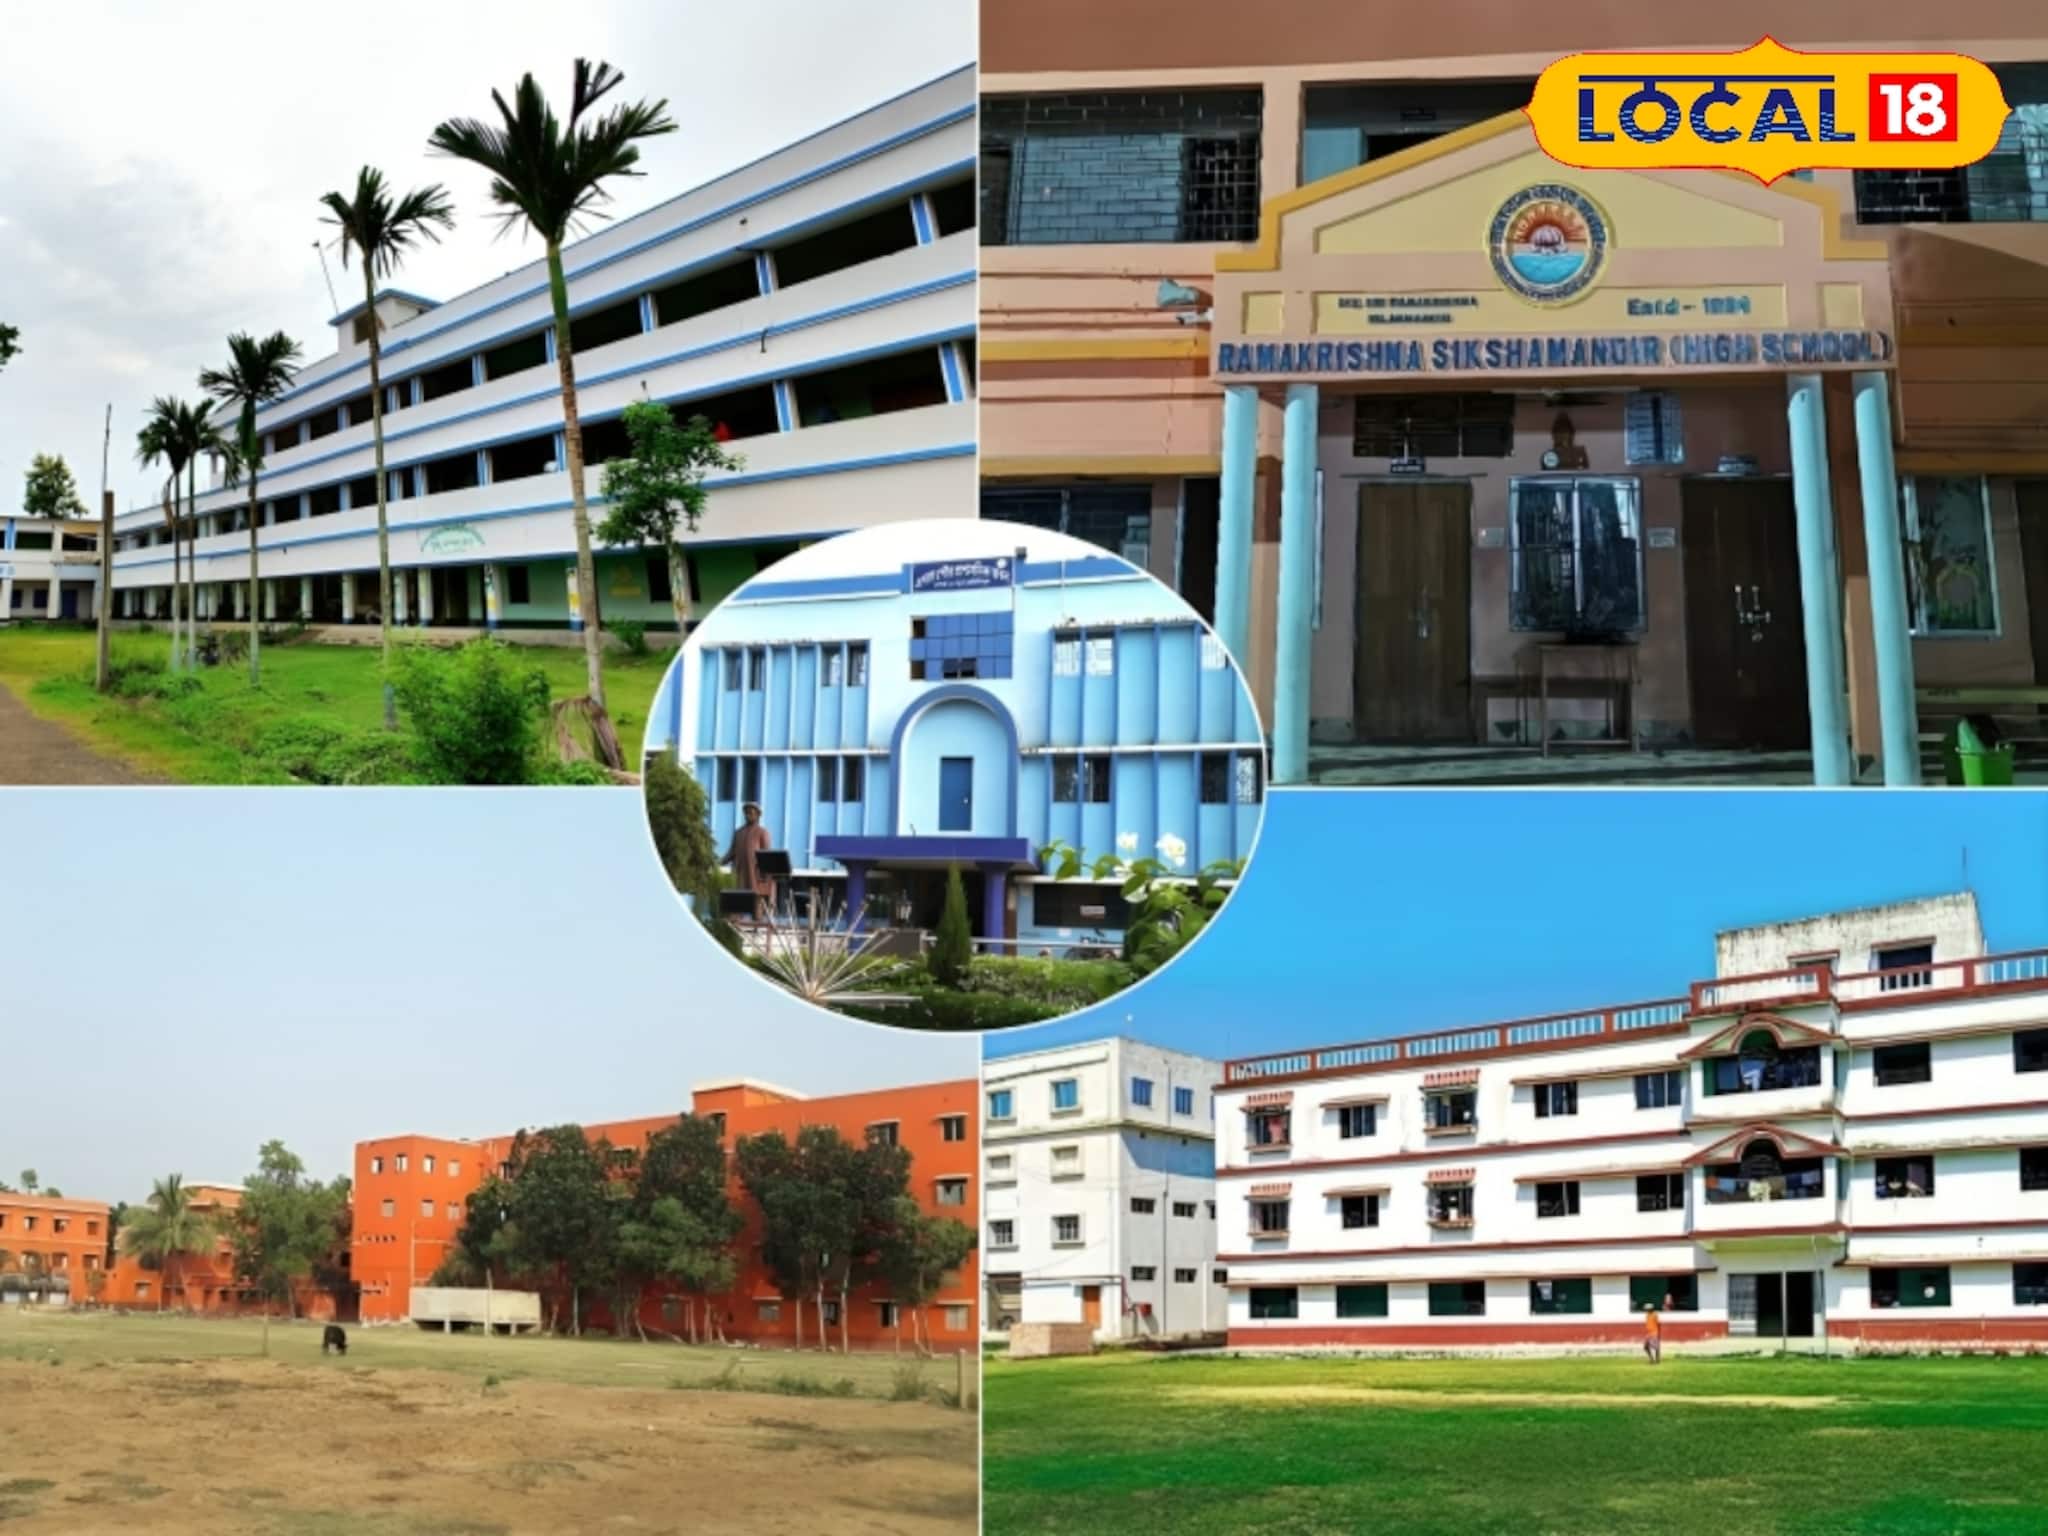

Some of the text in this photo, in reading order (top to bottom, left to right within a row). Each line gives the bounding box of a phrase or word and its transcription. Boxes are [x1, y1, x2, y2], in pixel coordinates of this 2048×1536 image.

[1218, 331, 1894, 373] RAMAKRISHNA SIKSHAMANDIR (HIGH SCHOOL)
